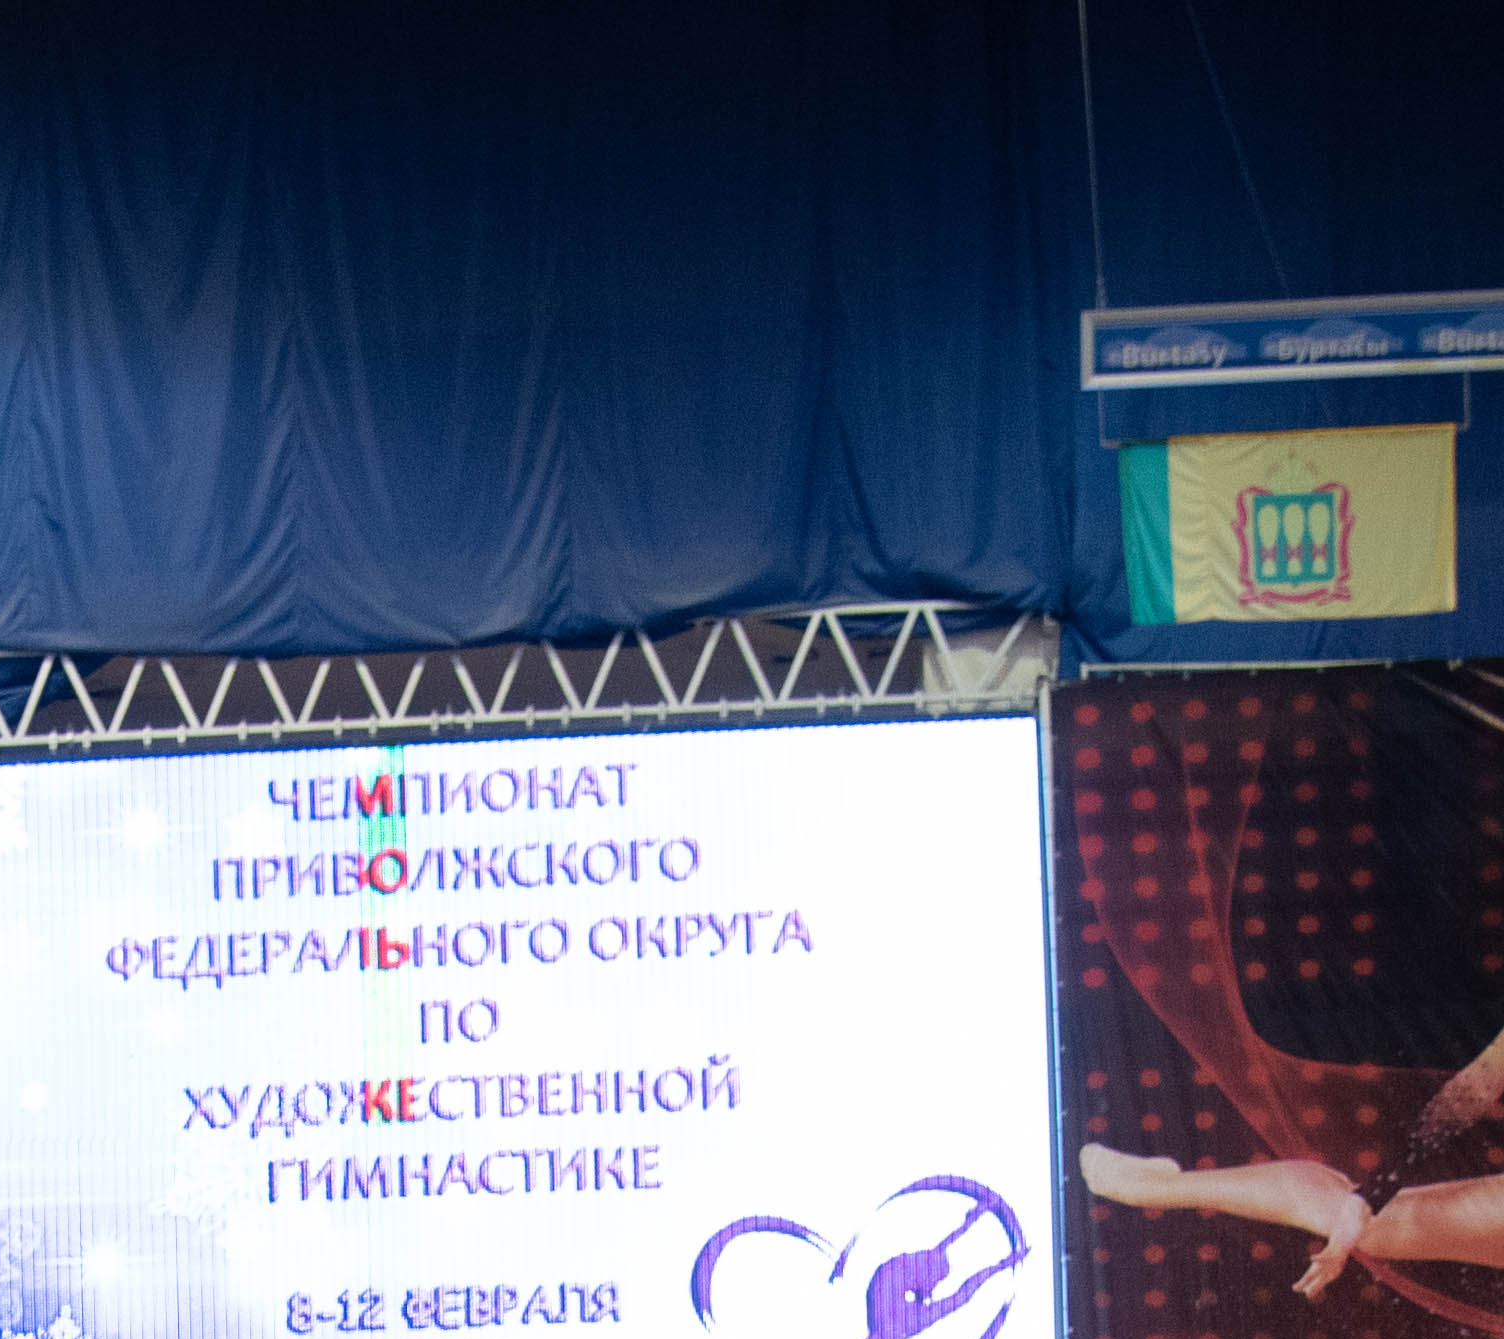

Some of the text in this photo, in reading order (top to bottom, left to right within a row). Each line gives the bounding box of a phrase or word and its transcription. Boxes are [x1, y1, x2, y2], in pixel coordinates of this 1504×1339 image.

[267, 763, 639, 821] ЧЕМПИОНАТ
[212, 835, 701, 900] ПРИВОЛЖСКОГО
[105, 909, 814, 990] ФЕДЕРАЛЬНОГО ОКРУГА
[419, 997, 499, 1044] ПО
[182, 1053, 741, 1139] ХУДОЖЕСТВЕННОЙ
[266, 1144, 664, 1204] ГИМНАСТИКЕ
[401, 1282, 621, 1330] ФЕВРАЛЯ
